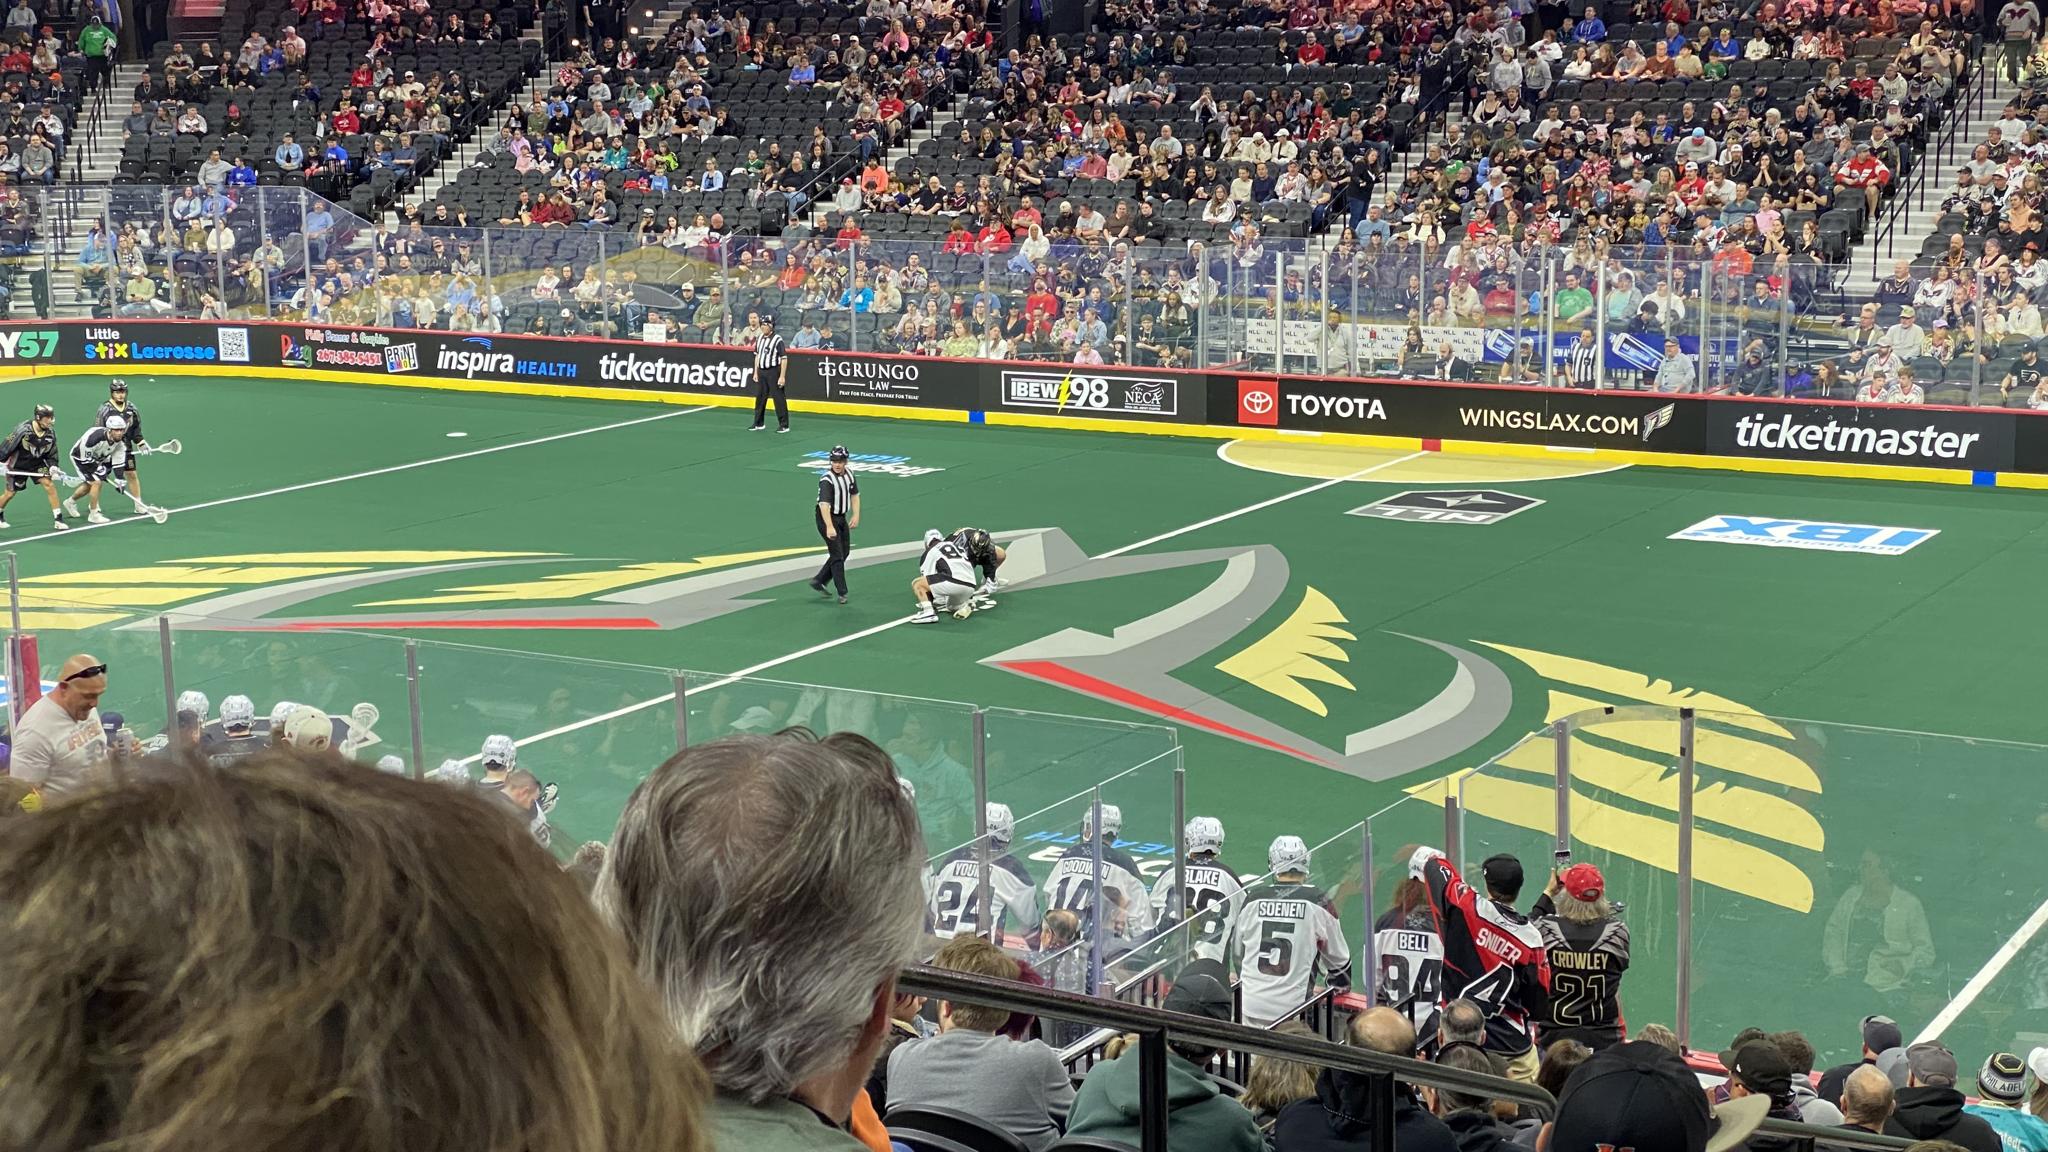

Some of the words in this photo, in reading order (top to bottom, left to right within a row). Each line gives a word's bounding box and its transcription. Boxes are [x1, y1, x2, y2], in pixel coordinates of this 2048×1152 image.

[86, 327, 120, 341] Little
[305, 329, 324, 343] Philly
[325, 330, 350, 343] Banner
[351, 332, 359, 343] &
[360, 332, 390, 347] Graphics
[131, 342, 216, 361] Lacrosse
[437, 345, 514, 378] inspira
[516, 360, 577, 378] HEALTH
[599, 354, 753, 388] ticketmaster
[838, 361, 919, 381] GRUNGO
[869, 380, 890, 390] LAW
[1011, 381, 1060, 400] IBEW
[1073, 377, 1110, 408] 98
[1124, 390, 1161, 405] NECA
[1286, 394, 1387, 421] TOYOTA
[1459, 408, 1638, 436] WINGSLAX.COM
[1735, 413, 1980, 459] ticketmaster
[1373, 507, 1492, 522] NLL
[1703, 517, 1929, 548] IBX
[935, 881, 995, 932] 24
[1259, 902, 1304, 919] SOENEN
[1257, 921, 1296, 977] 5
[1399, 932, 1428, 951] BELL
[1476, 928, 1522, 962] SNIDER
[1552, 950, 1609, 970] CROWLEY
[1382, 954, 1443, 1002] 94
[1457, 961, 1515, 1019] 4
[1553, 973, 1606, 1027] 21
